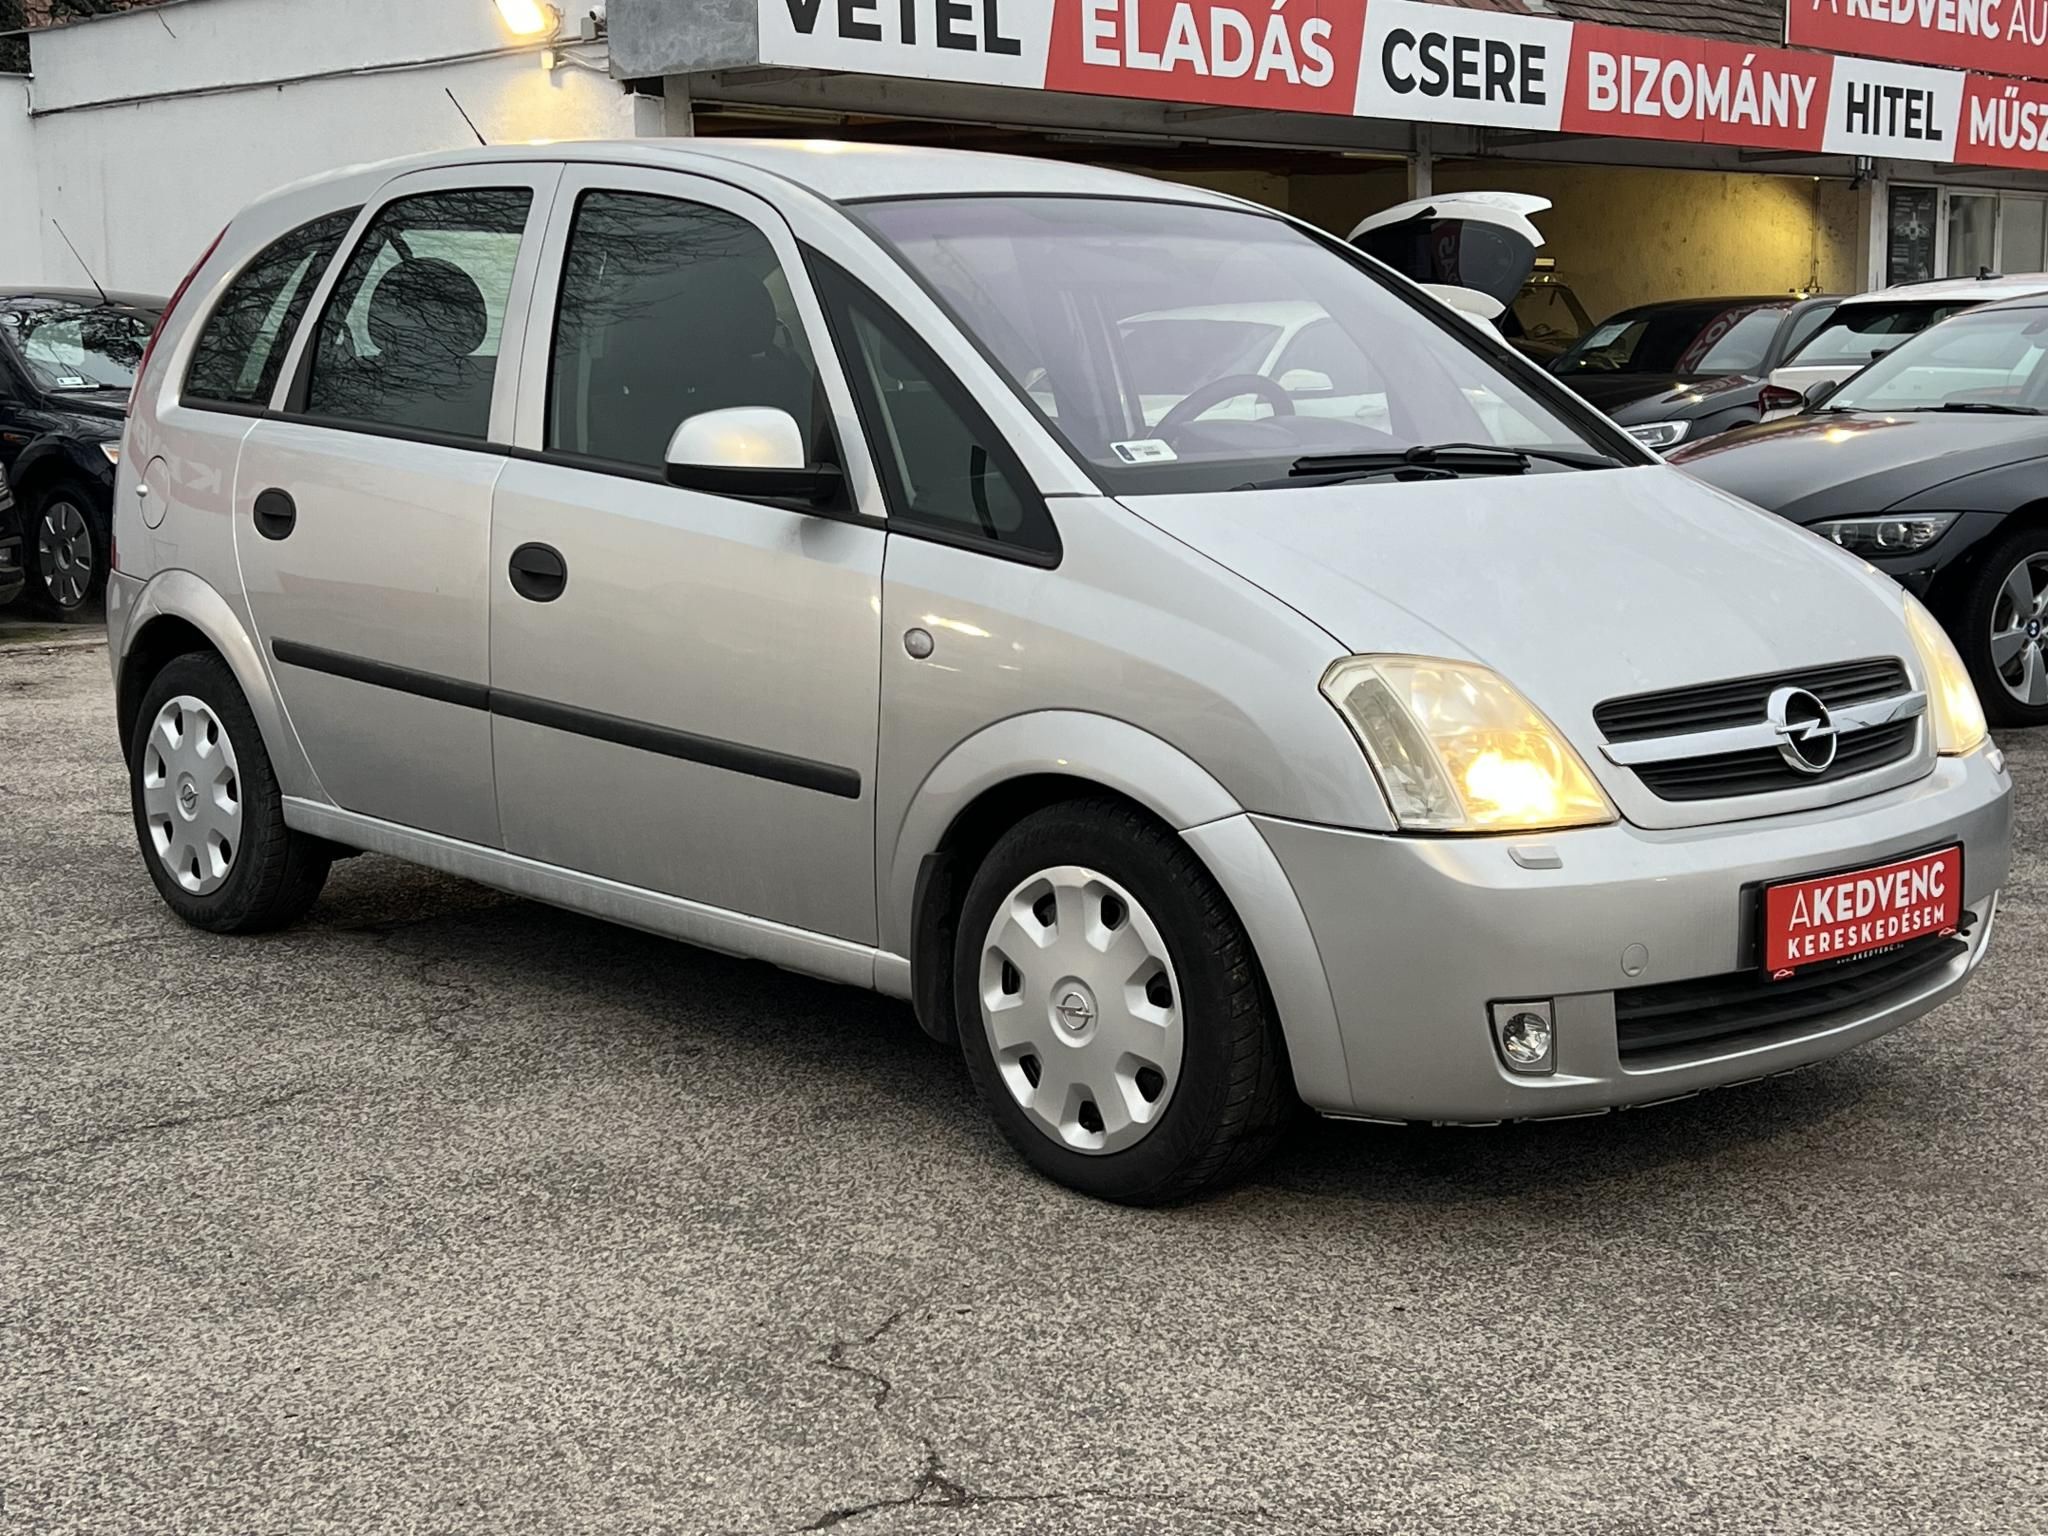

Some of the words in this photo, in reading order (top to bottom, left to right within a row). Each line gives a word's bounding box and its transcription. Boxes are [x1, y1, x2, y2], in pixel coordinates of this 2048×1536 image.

[1082, 0, 1335, 88] ELADÁS
[1381, 28, 1546, 106] CSERE
[1588, 51, 1817, 129] BIZOMÁNY
[1846, 81, 1943, 141] HITEL
[1787, 903, 1945, 960] KERESKEDÉSEM
